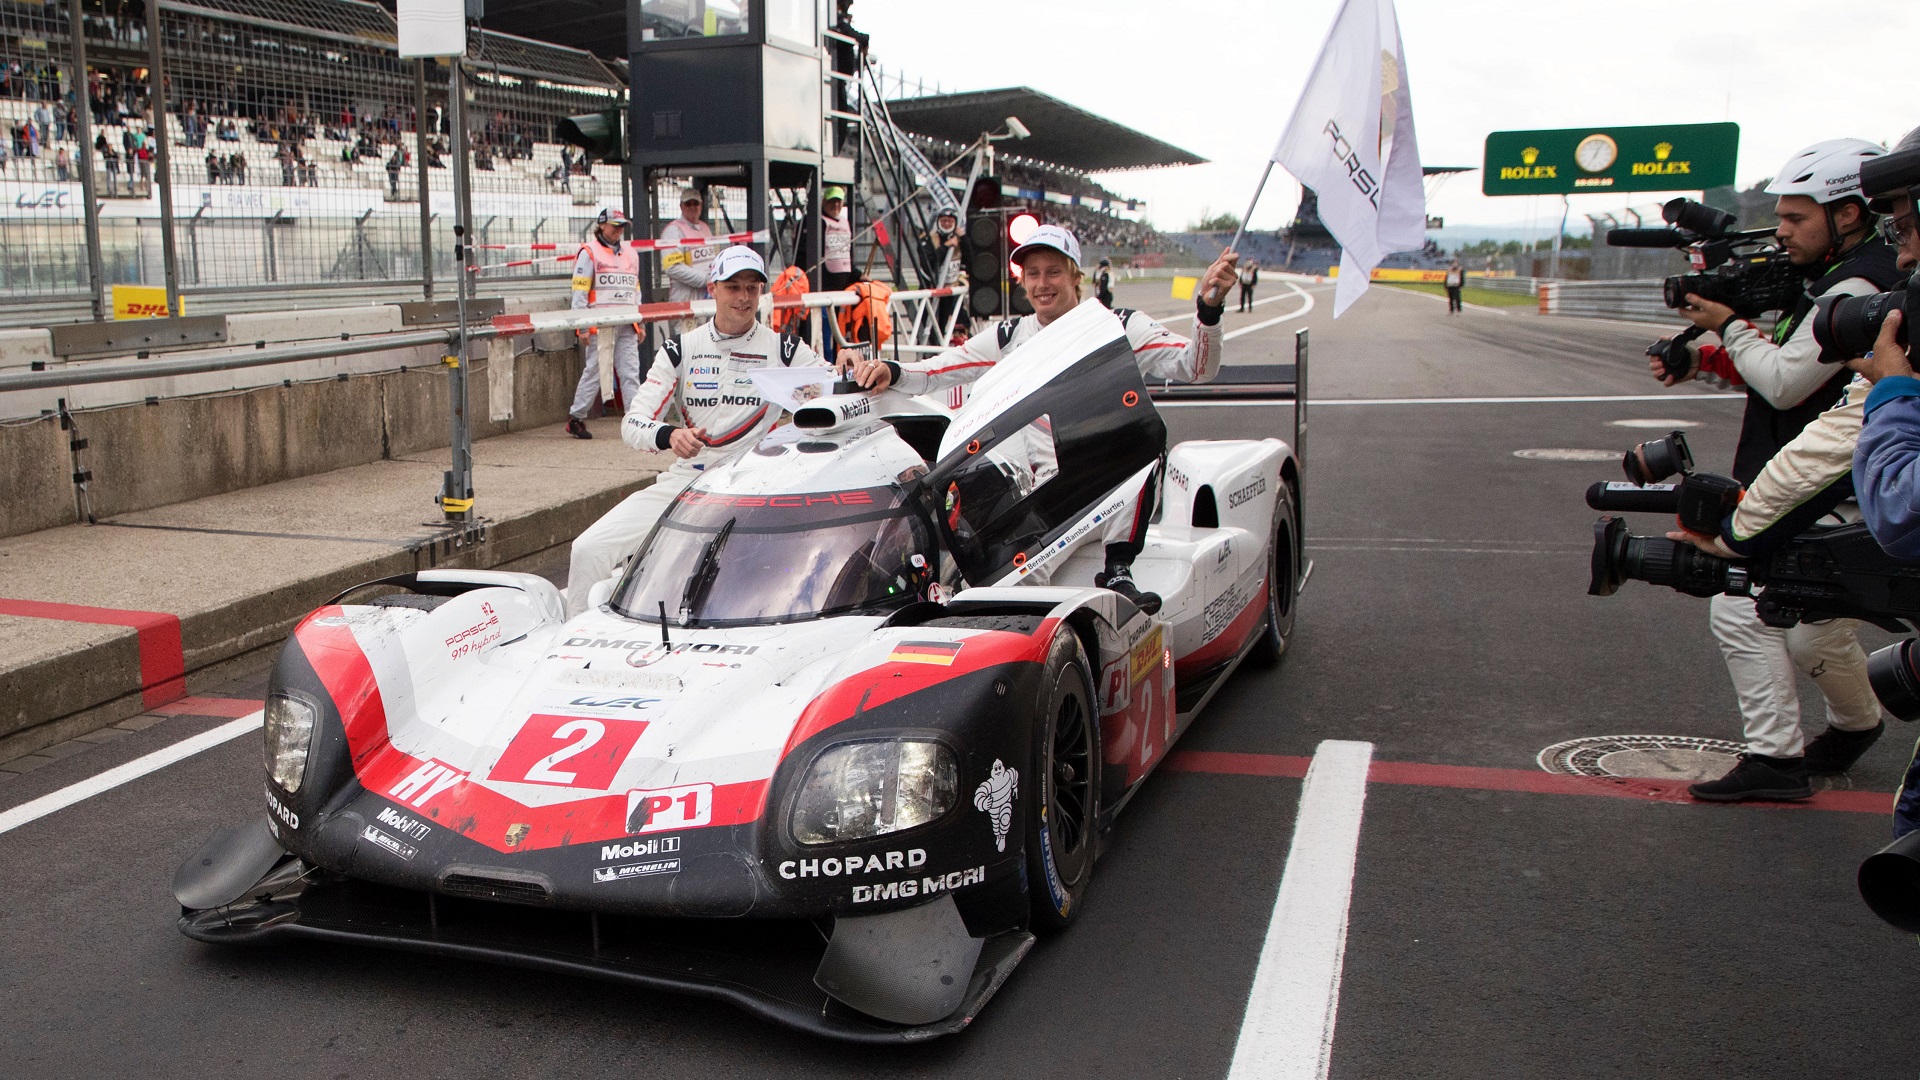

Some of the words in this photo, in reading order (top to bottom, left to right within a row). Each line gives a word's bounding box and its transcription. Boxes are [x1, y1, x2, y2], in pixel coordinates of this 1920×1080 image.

[1500, 165, 1558, 180] ROLEX
[1631, 161, 1692, 176] ROLEX
[126, 303, 169, 317] DHL
[686, 396, 719, 408] DMG
[721, 394, 761, 407] MORI
[677, 490, 873, 507] PORSCHE
[1228, 477, 1267, 510] SCHAEFFLER
[1100, 499, 1126, 519] Hartley
[1064, 522, 1091, 545] Bamber
[1026, 547, 1057, 571] Bernhard
[445, 615, 499, 648] PORSCHE
[451, 644, 469, 661] 919
[470, 626, 502, 656] hybrid
[561, 637, 653, 650] DMG
[653, 642, 760, 656] MORI
[569, 696, 663, 710] WEC
[1140, 678, 1153, 767] 2
[523, 719, 606, 785] 2
[388, 760, 465, 808] HY
[376, 806, 418, 834] Mobil
[642, 790, 698, 826] P1
[601, 838, 658, 861] Mobil
[618, 861, 679, 876] MICHELIN
[778, 848, 928, 880] CHOPARD
[1043, 831, 1062, 900] MICHELIN
[852, 878, 918, 904] DMG
[922, 865, 986, 896] MORI
